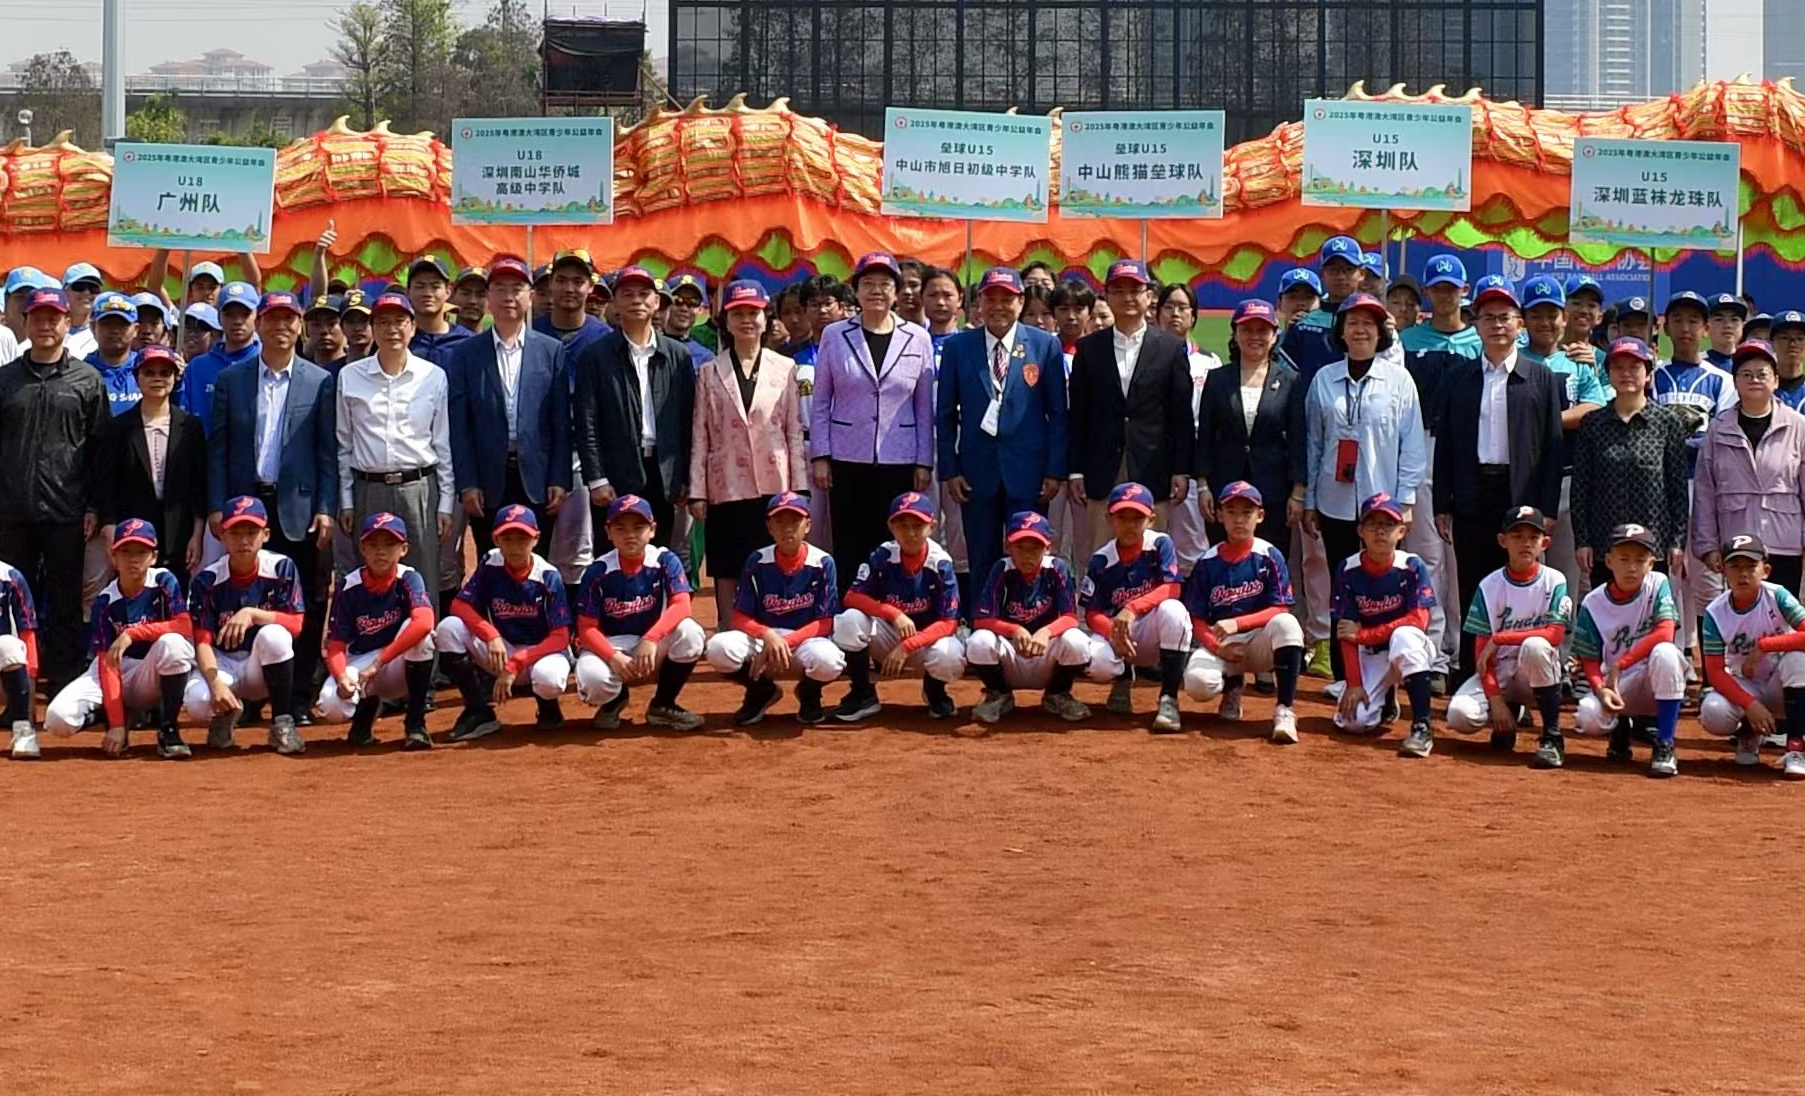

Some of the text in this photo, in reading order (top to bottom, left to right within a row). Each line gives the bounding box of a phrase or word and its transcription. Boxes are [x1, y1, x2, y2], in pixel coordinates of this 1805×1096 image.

[1372, 133, 1400, 144] U15
[940, 142, 994, 155] 垒球U15
[1115, 143, 1167, 155] 垒球U15
[517, 150, 543, 161] U18
[1352, 149, 1419, 171] 深圳队
[482, 165, 581, 179] 深圳南山华侨城
[896, 158, 1037, 179] 中山市旭日初级中学队
[1078, 163, 1203, 181] 中山熊猫垒球队
[178, 175, 204, 187] U18
[1641, 171, 1668, 182] U15
[496, 182, 566, 195] 高级中学队
[156, 192, 221, 213] 广州队
[1593, 186, 1724, 208] 深圳蓝袜龙珠队
